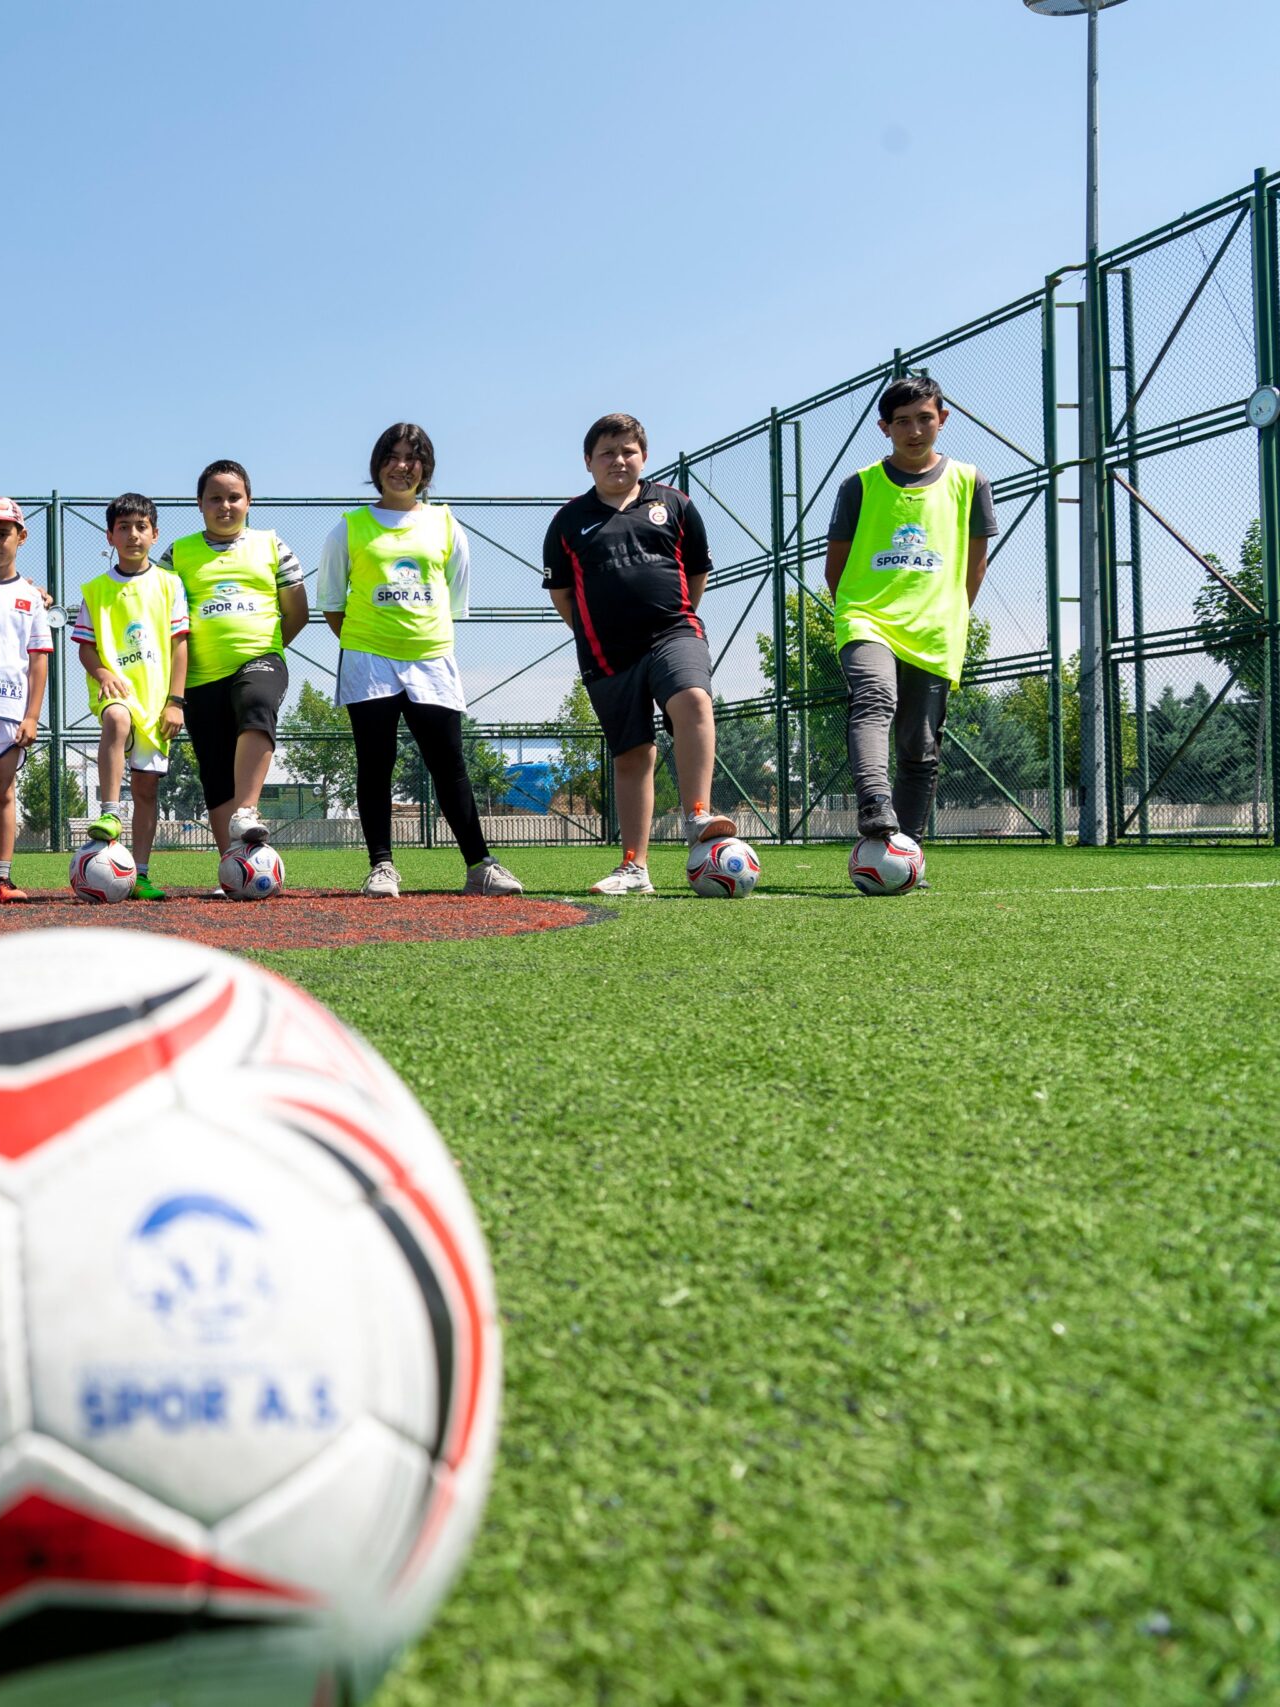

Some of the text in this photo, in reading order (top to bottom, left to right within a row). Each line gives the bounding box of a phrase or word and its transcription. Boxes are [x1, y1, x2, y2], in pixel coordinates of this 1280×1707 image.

[876, 555, 909, 567] SPOR
[377, 591, 408, 602] SPOR
[202, 602, 232, 615] SPOR
[116, 651, 142, 667] SPOR
[80, 1374, 227, 1437] SPOR
